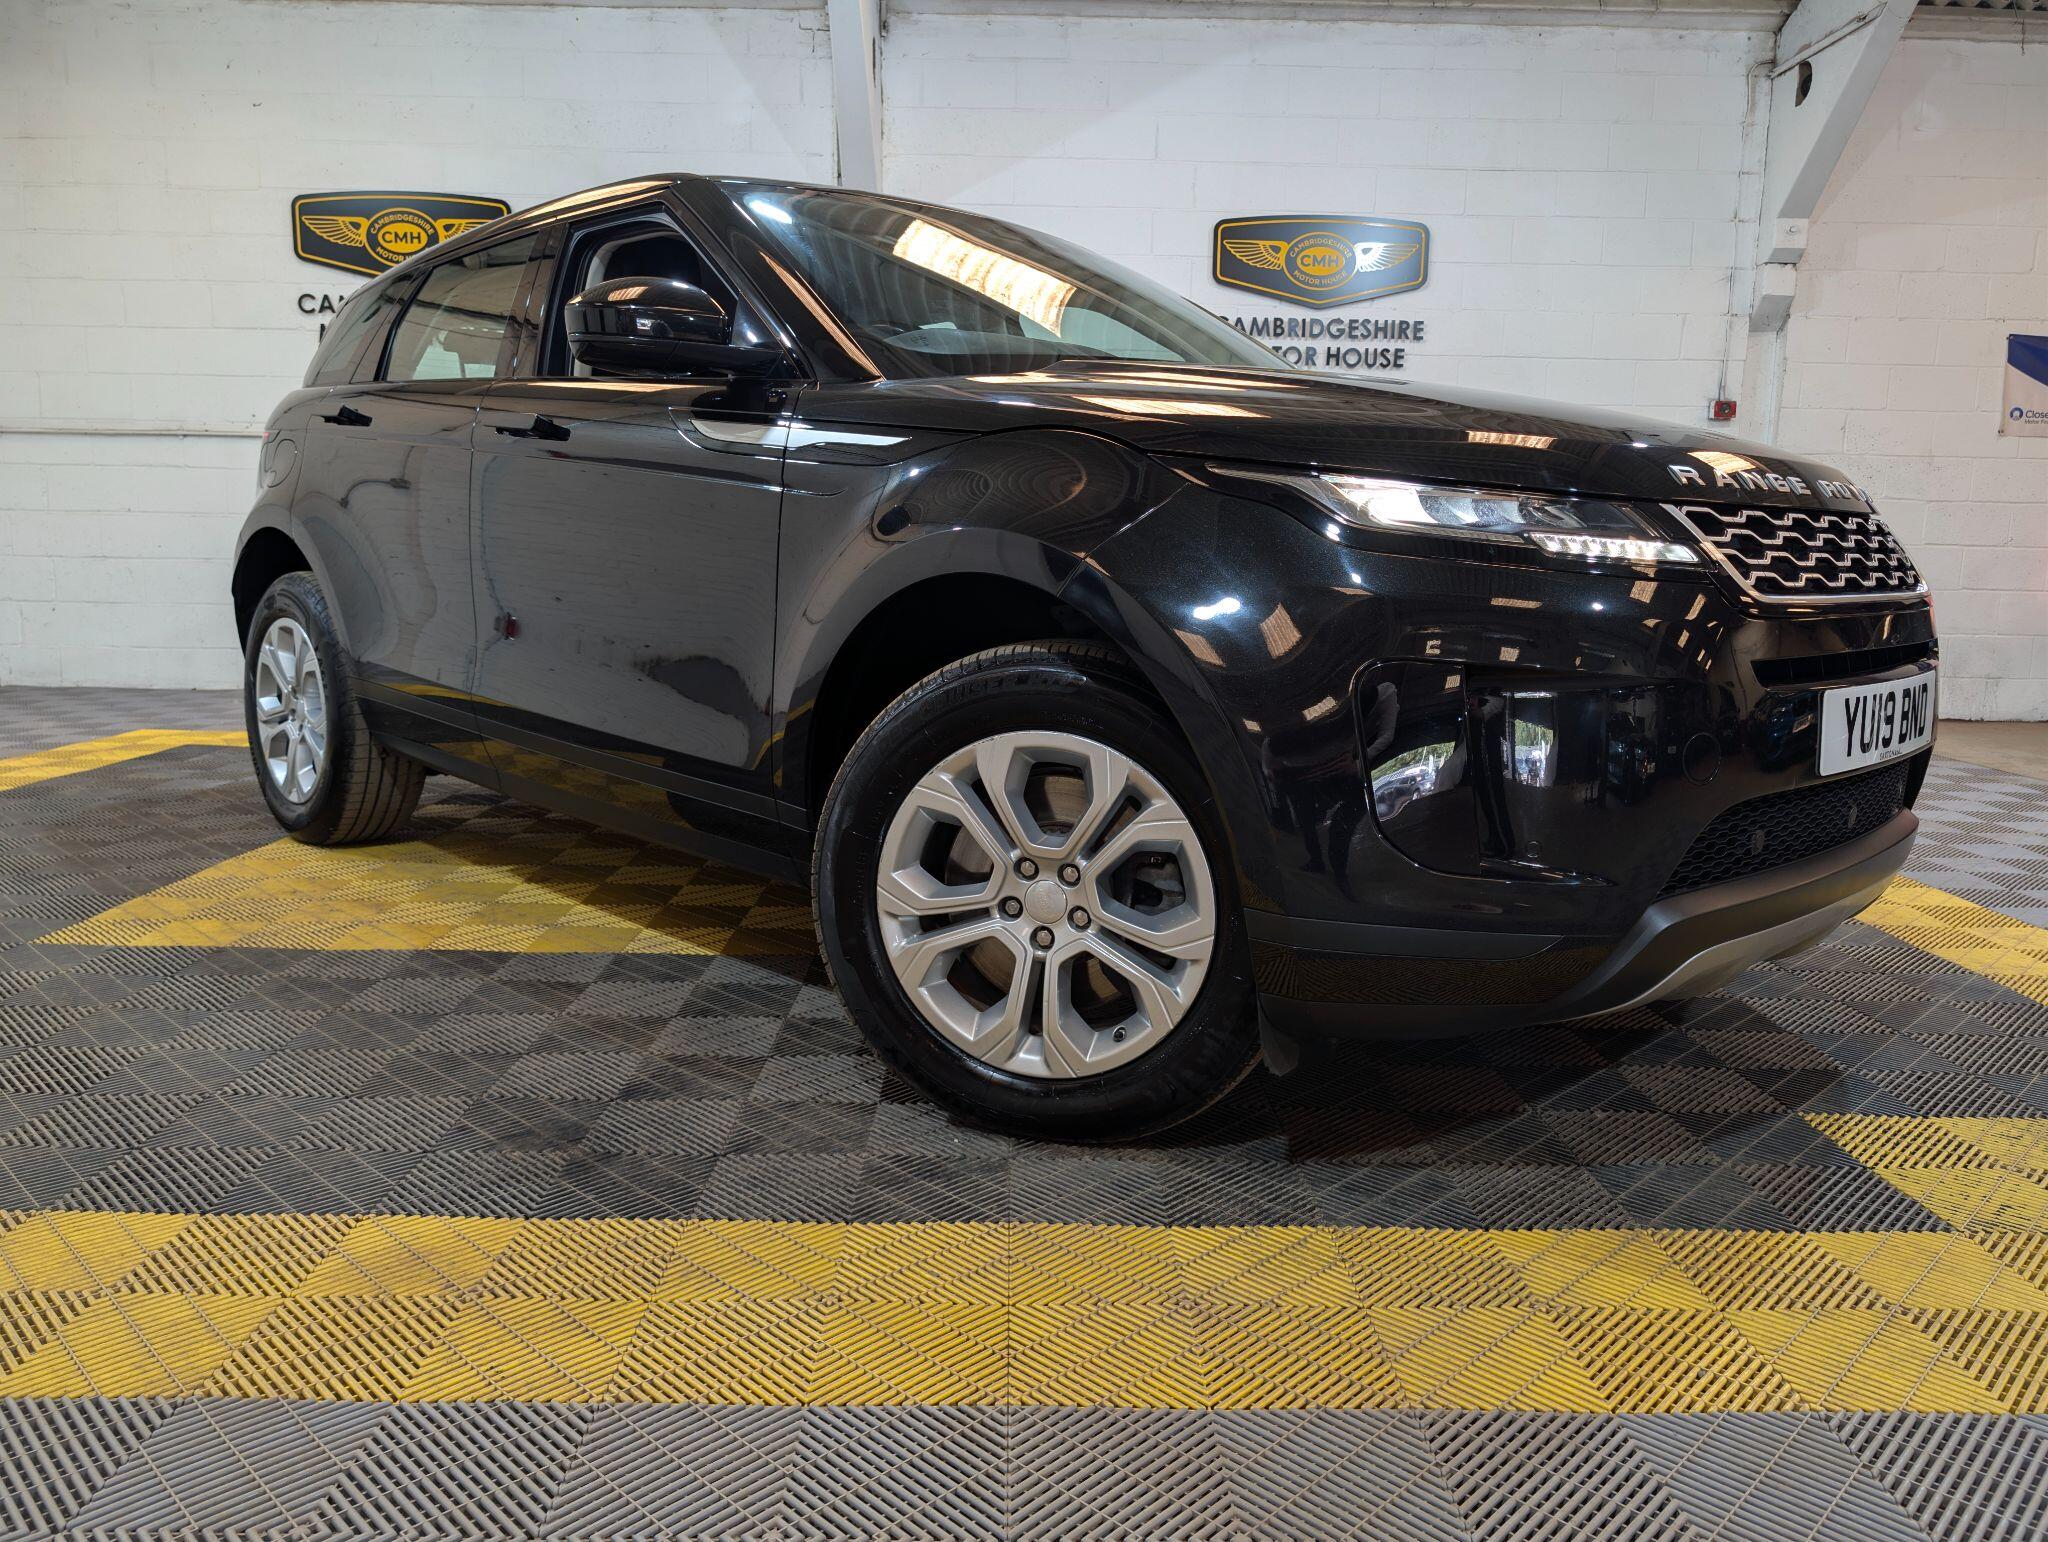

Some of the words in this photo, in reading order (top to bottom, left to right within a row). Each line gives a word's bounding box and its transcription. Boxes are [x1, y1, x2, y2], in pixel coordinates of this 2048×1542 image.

[370, 214, 435, 236] CAMBRIDGESHIRE
[381, 231, 422, 244] CMH
[376, 246, 405, 262] MOTOR
[1300, 254, 1339, 267] CMH
[1293, 270, 1319, 284] MOTOR
[1326, 347, 1406, 369] HOUSE
[1667, 465, 1812, 496] RANGE
[1844, 691, 1897, 757] YU19
[1898, 683, 1928, 744] BND
